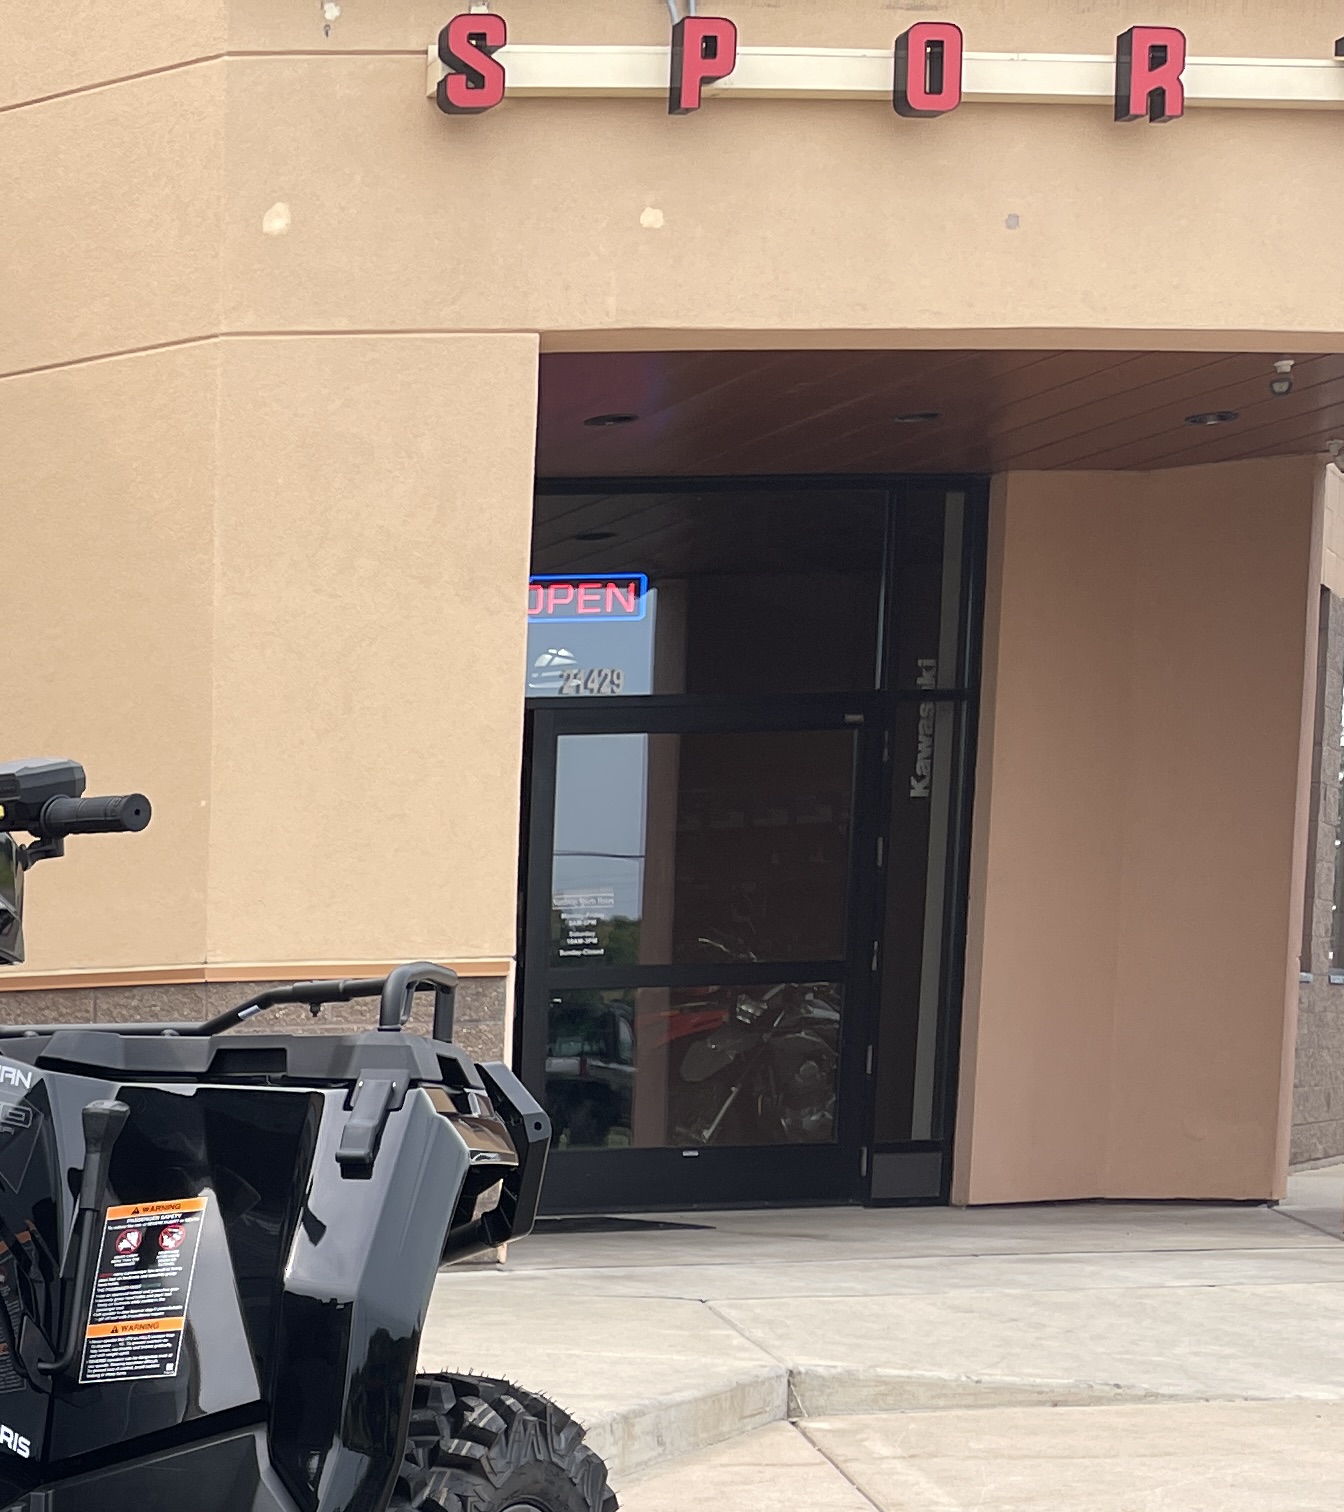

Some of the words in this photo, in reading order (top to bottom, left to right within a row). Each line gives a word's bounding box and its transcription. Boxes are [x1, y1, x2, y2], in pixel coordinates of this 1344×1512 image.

[436, 13, 1344, 123] SPOR
[558, 668, 624, 695] 21429
[910, 658, 937, 798] Kawaski
[142, 1203, 181, 1213] WARNING
[121, 1322, 160, 1332] WARNING
